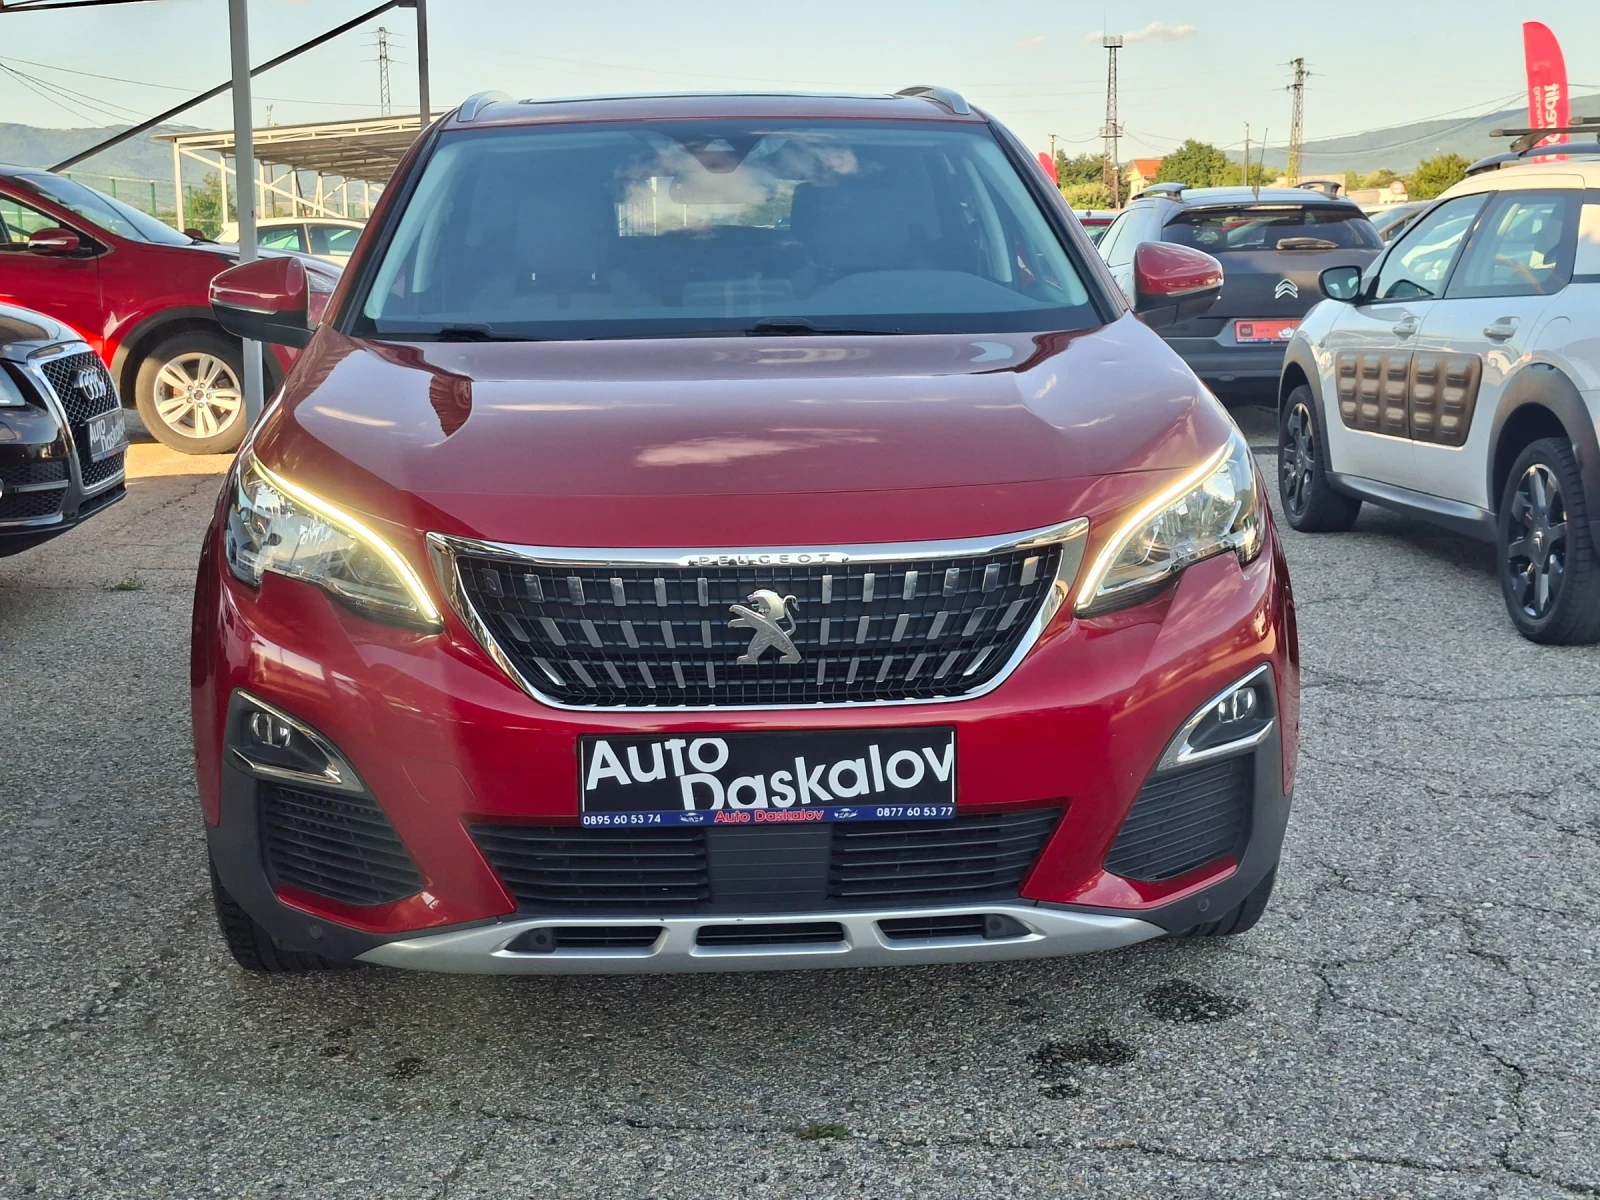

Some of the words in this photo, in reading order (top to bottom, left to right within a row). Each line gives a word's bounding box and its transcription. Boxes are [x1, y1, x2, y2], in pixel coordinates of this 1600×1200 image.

[697, 553, 831, 567] PEUGEOT
[585, 737, 729, 790] Auto
[679, 743, 954, 811] Daskalov
[714, 810, 751, 823] Auto
[754, 808, 825, 822] Daskalov
[876, 807, 903, 817] 0877
[906, 807, 921, 817] 60
[923, 806, 937, 816] 53
[940, 806, 953, 816] 77
[583, 815, 611, 825] 0895
[613, 815, 627, 824] 60
[630, 814, 644, 824] 53
[648, 814, 661, 823] 74
